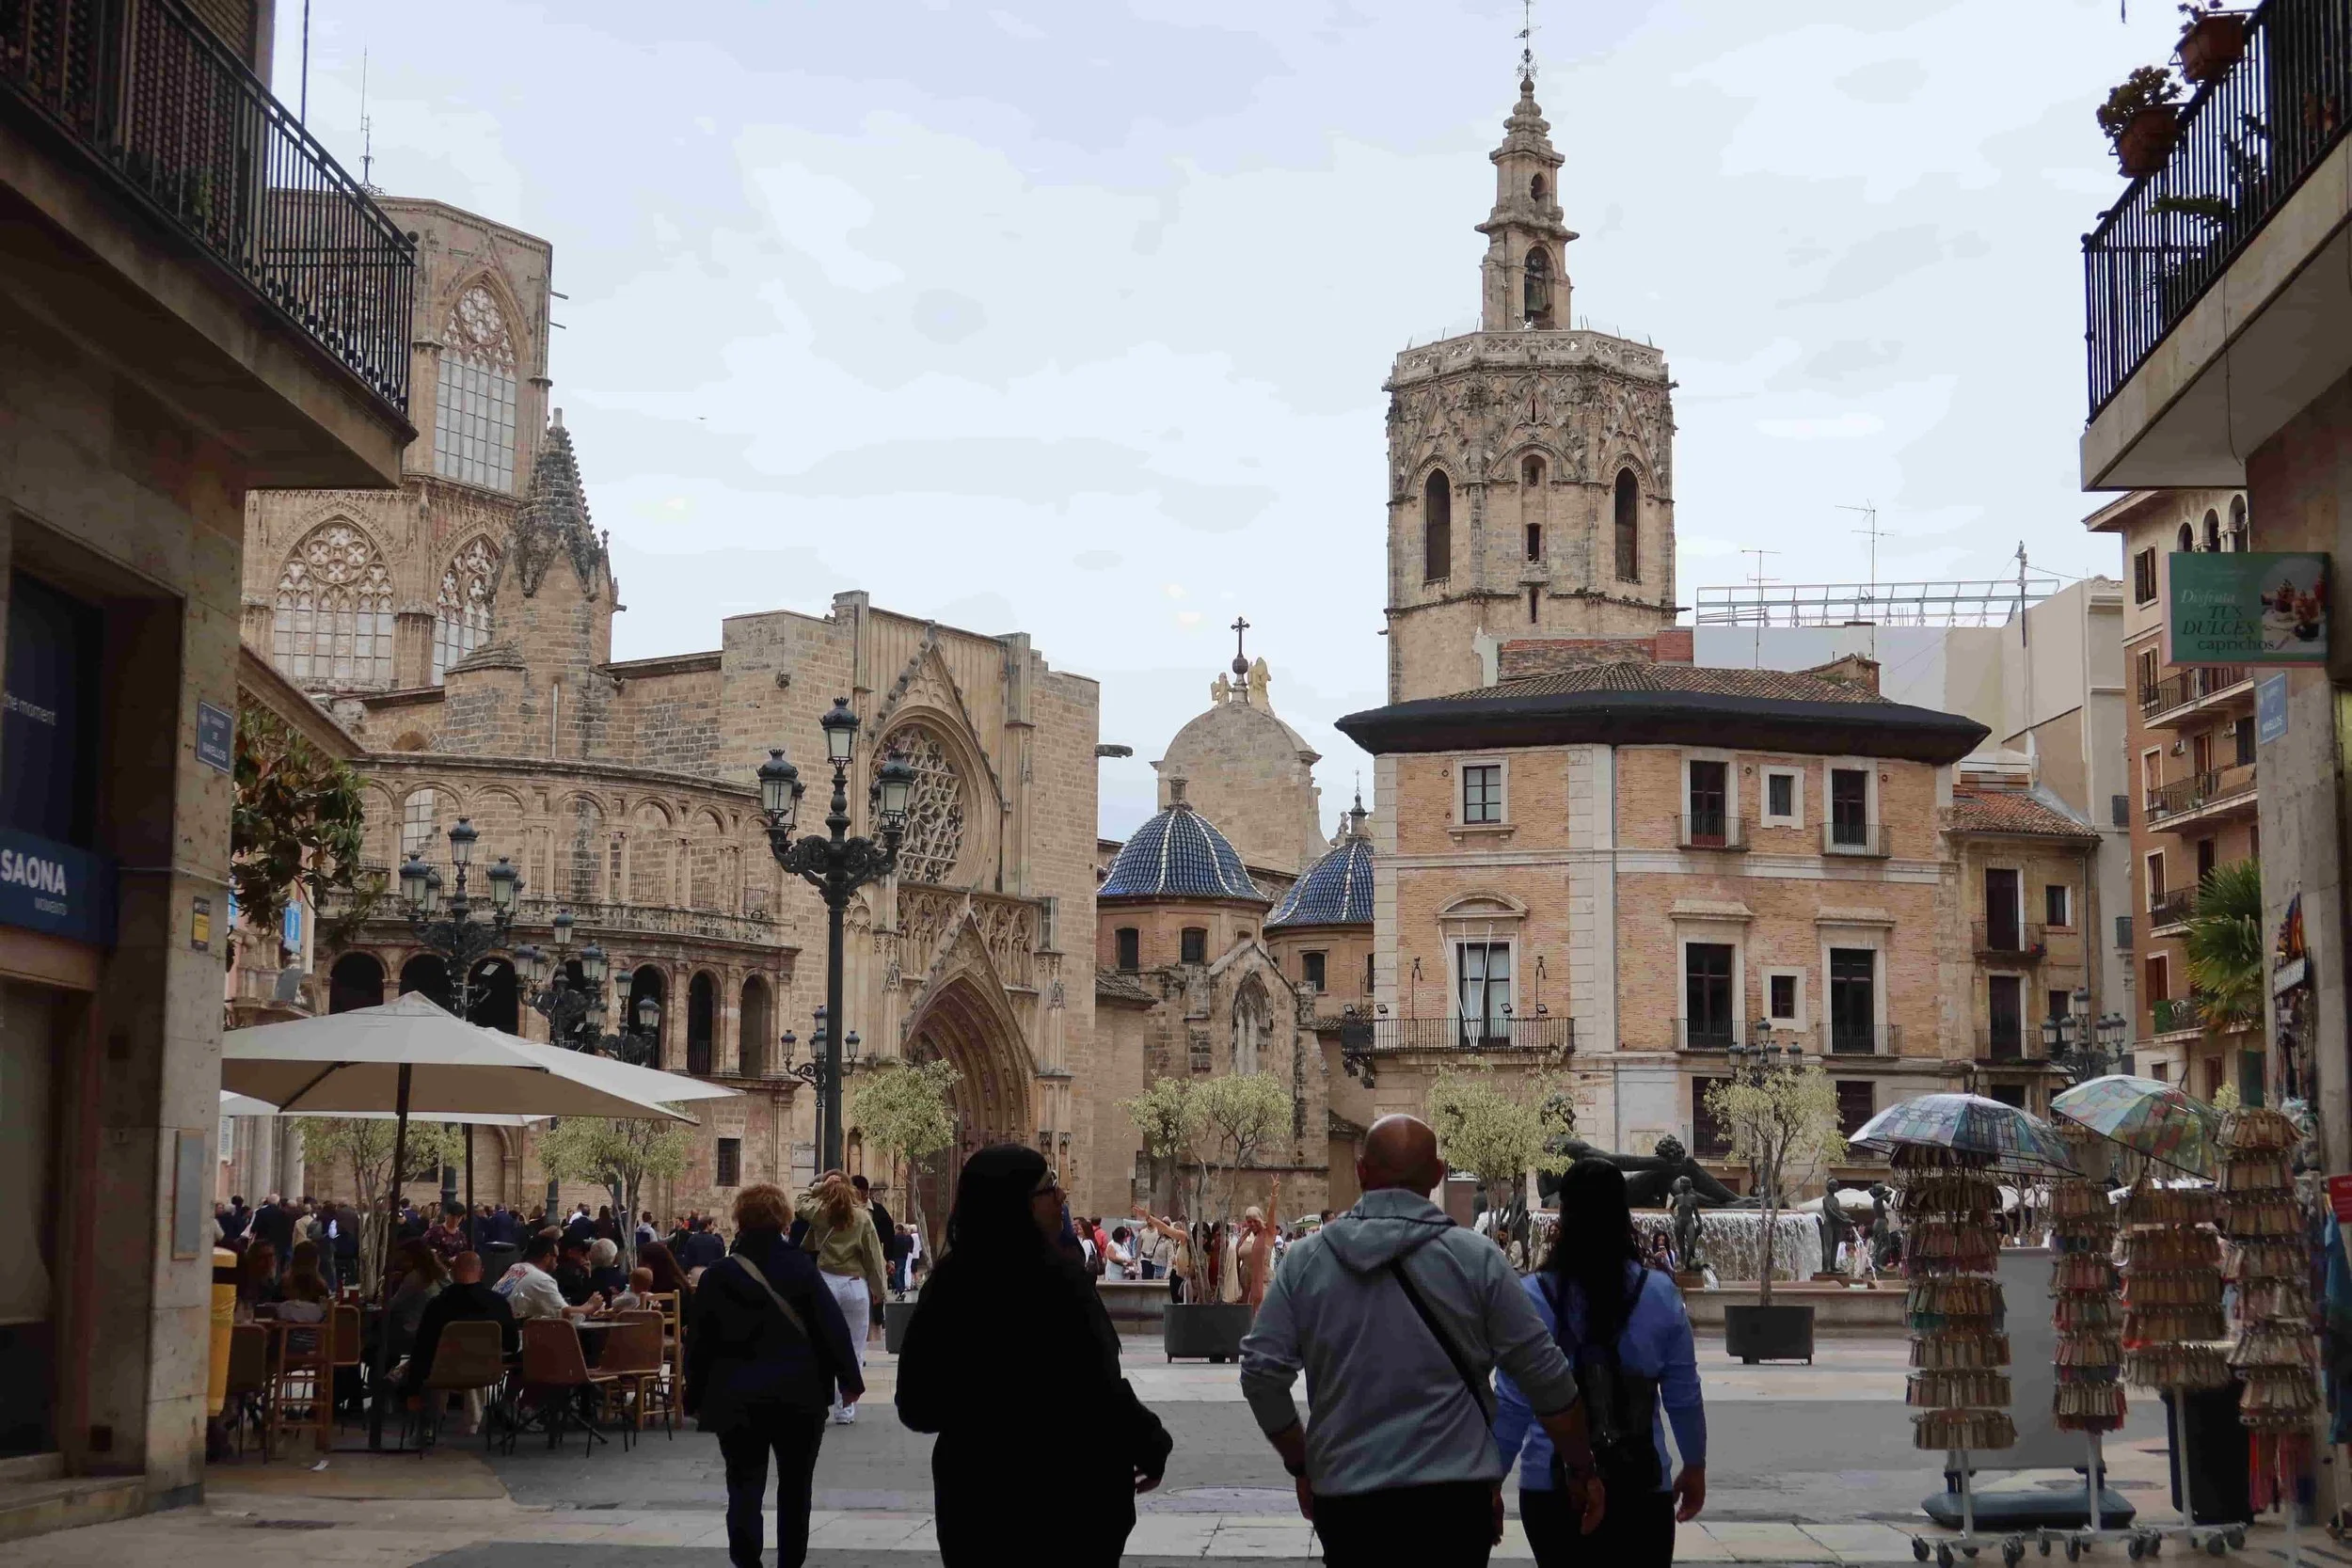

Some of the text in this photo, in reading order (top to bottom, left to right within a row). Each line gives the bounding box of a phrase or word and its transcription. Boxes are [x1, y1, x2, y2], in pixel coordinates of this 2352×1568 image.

[2181, 590, 2236, 608] Disfruta
[2182, 621, 2255, 636] DULCES
[2197, 637, 2275, 654] caprichos
[19, 700, 56, 726] moment
[1, 848, 67, 895] SAONA
